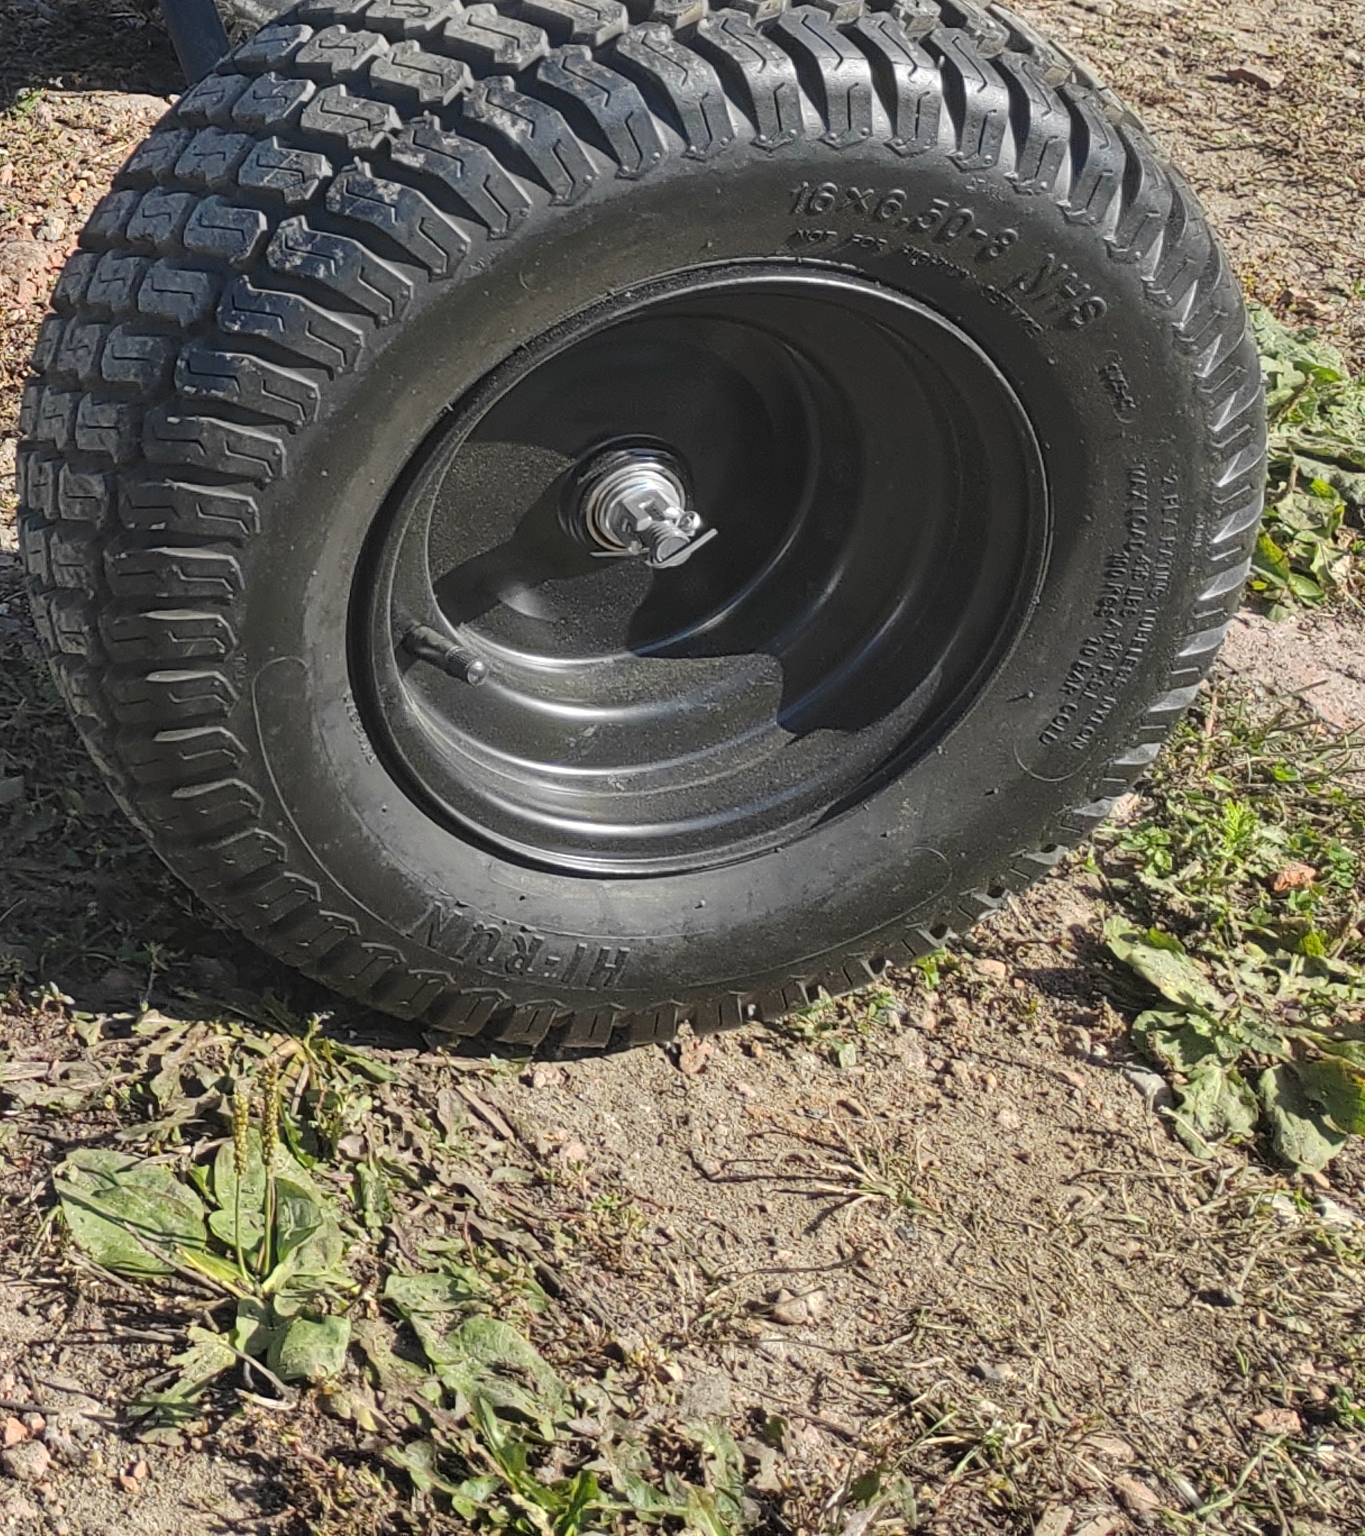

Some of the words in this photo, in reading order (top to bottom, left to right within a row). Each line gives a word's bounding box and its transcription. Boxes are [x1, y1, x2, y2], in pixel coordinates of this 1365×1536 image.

[1039, 702, 1079, 745] COLD
[1070, 695, 1118, 750] NYLON
[404, 901, 631, 988] HI-RUN
